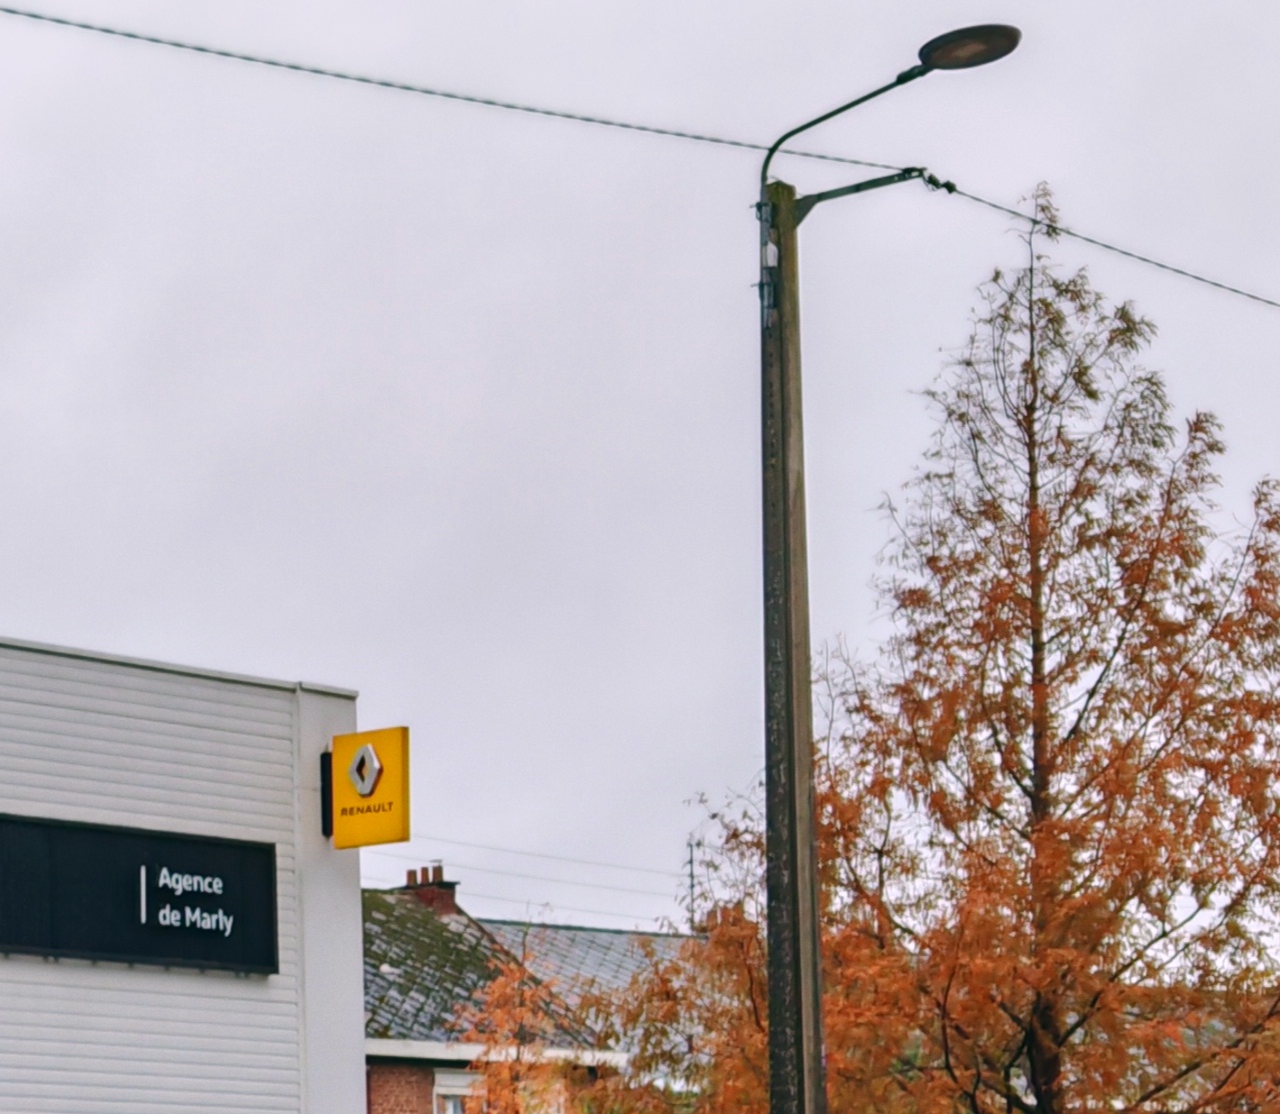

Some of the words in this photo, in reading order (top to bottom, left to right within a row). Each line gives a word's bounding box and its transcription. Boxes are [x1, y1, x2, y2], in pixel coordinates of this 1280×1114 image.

[341, 802, 394, 817] RENAULT
[158, 866, 223, 896] Agence
[158, 904, 182, 927] de
[184, 906, 234, 938] Marly
